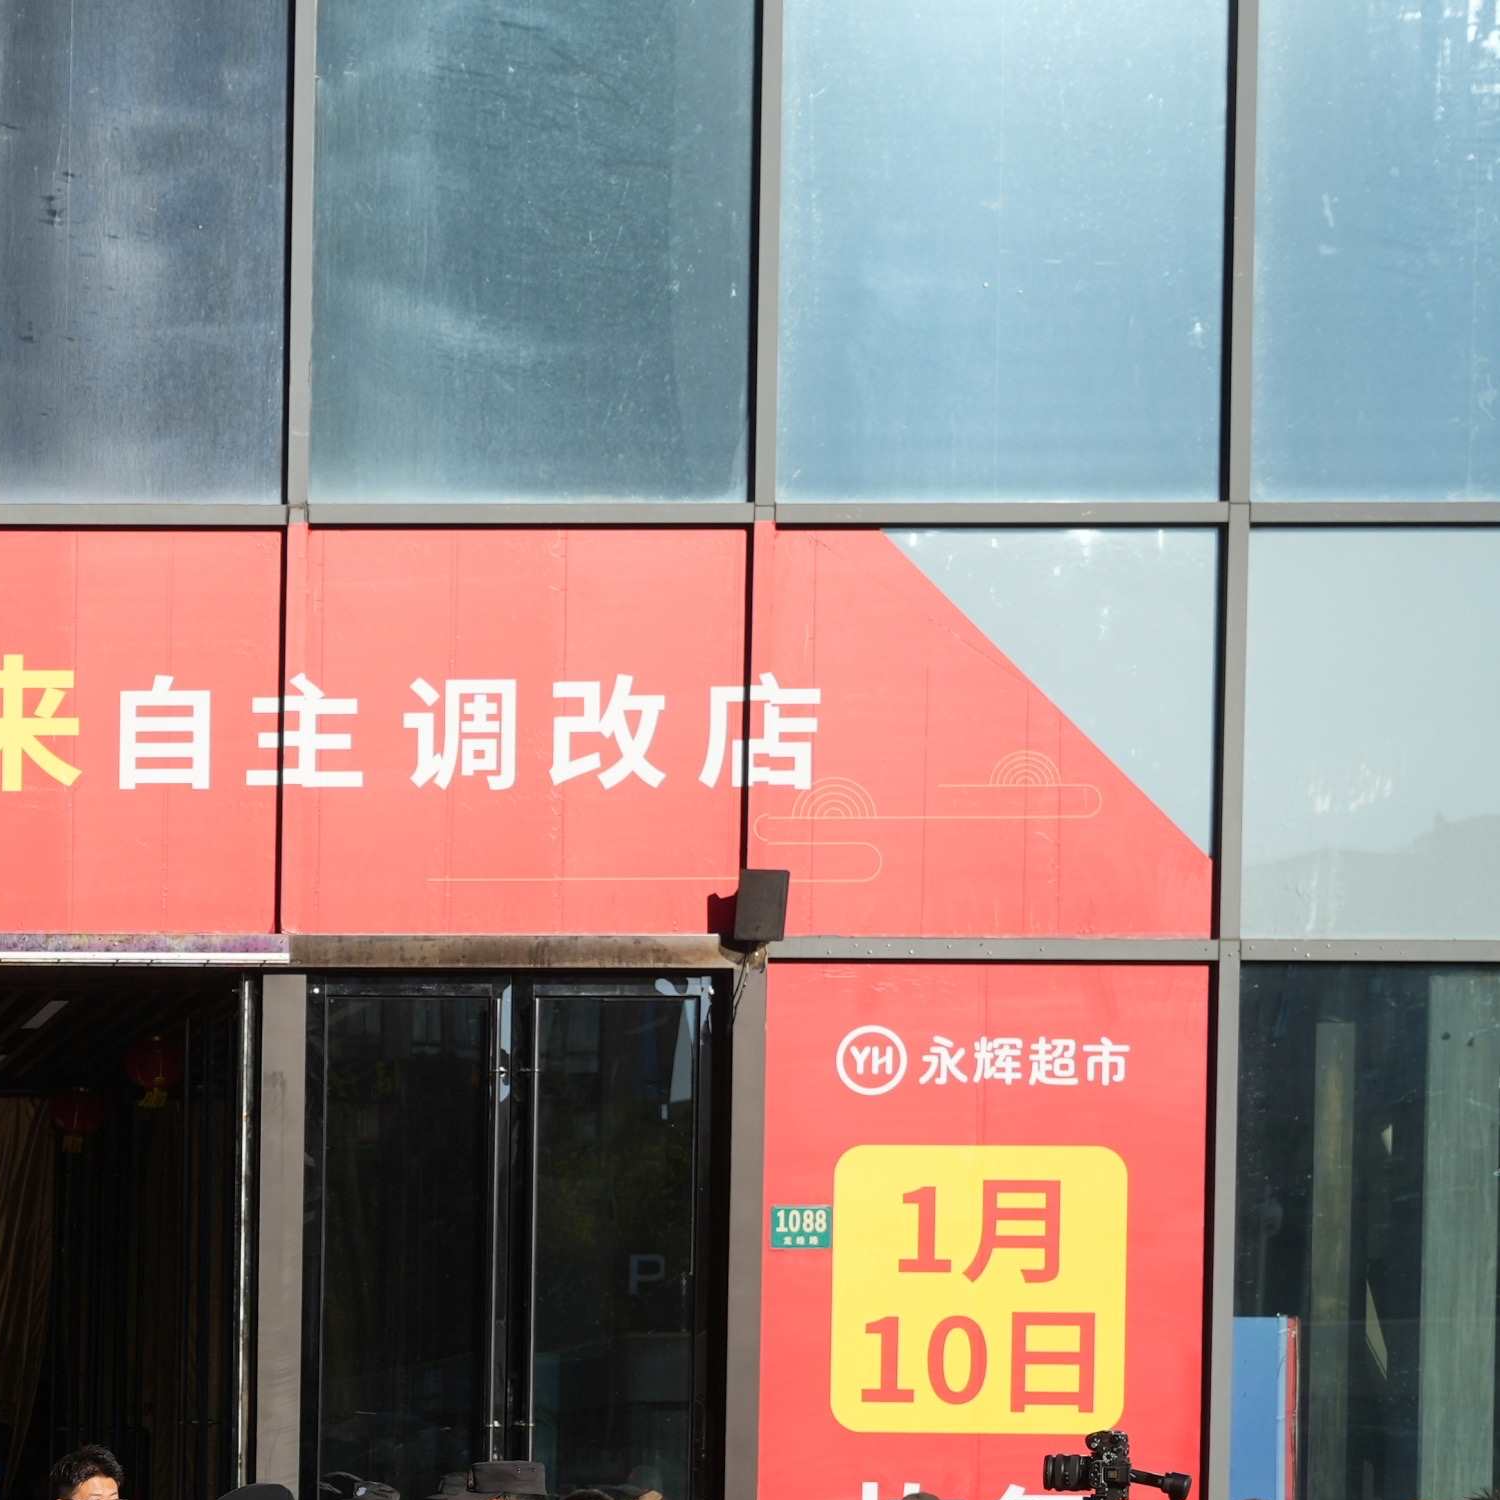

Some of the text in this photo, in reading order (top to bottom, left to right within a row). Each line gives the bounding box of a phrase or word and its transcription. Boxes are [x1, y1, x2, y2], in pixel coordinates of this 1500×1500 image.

[919, 1036, 1131, 1087] 永辉超市
[776, 1210, 827, 1233] 1088
[898, 1178, 1062, 1284] 1月
[860, 1312, 1097, 1414] 10日
